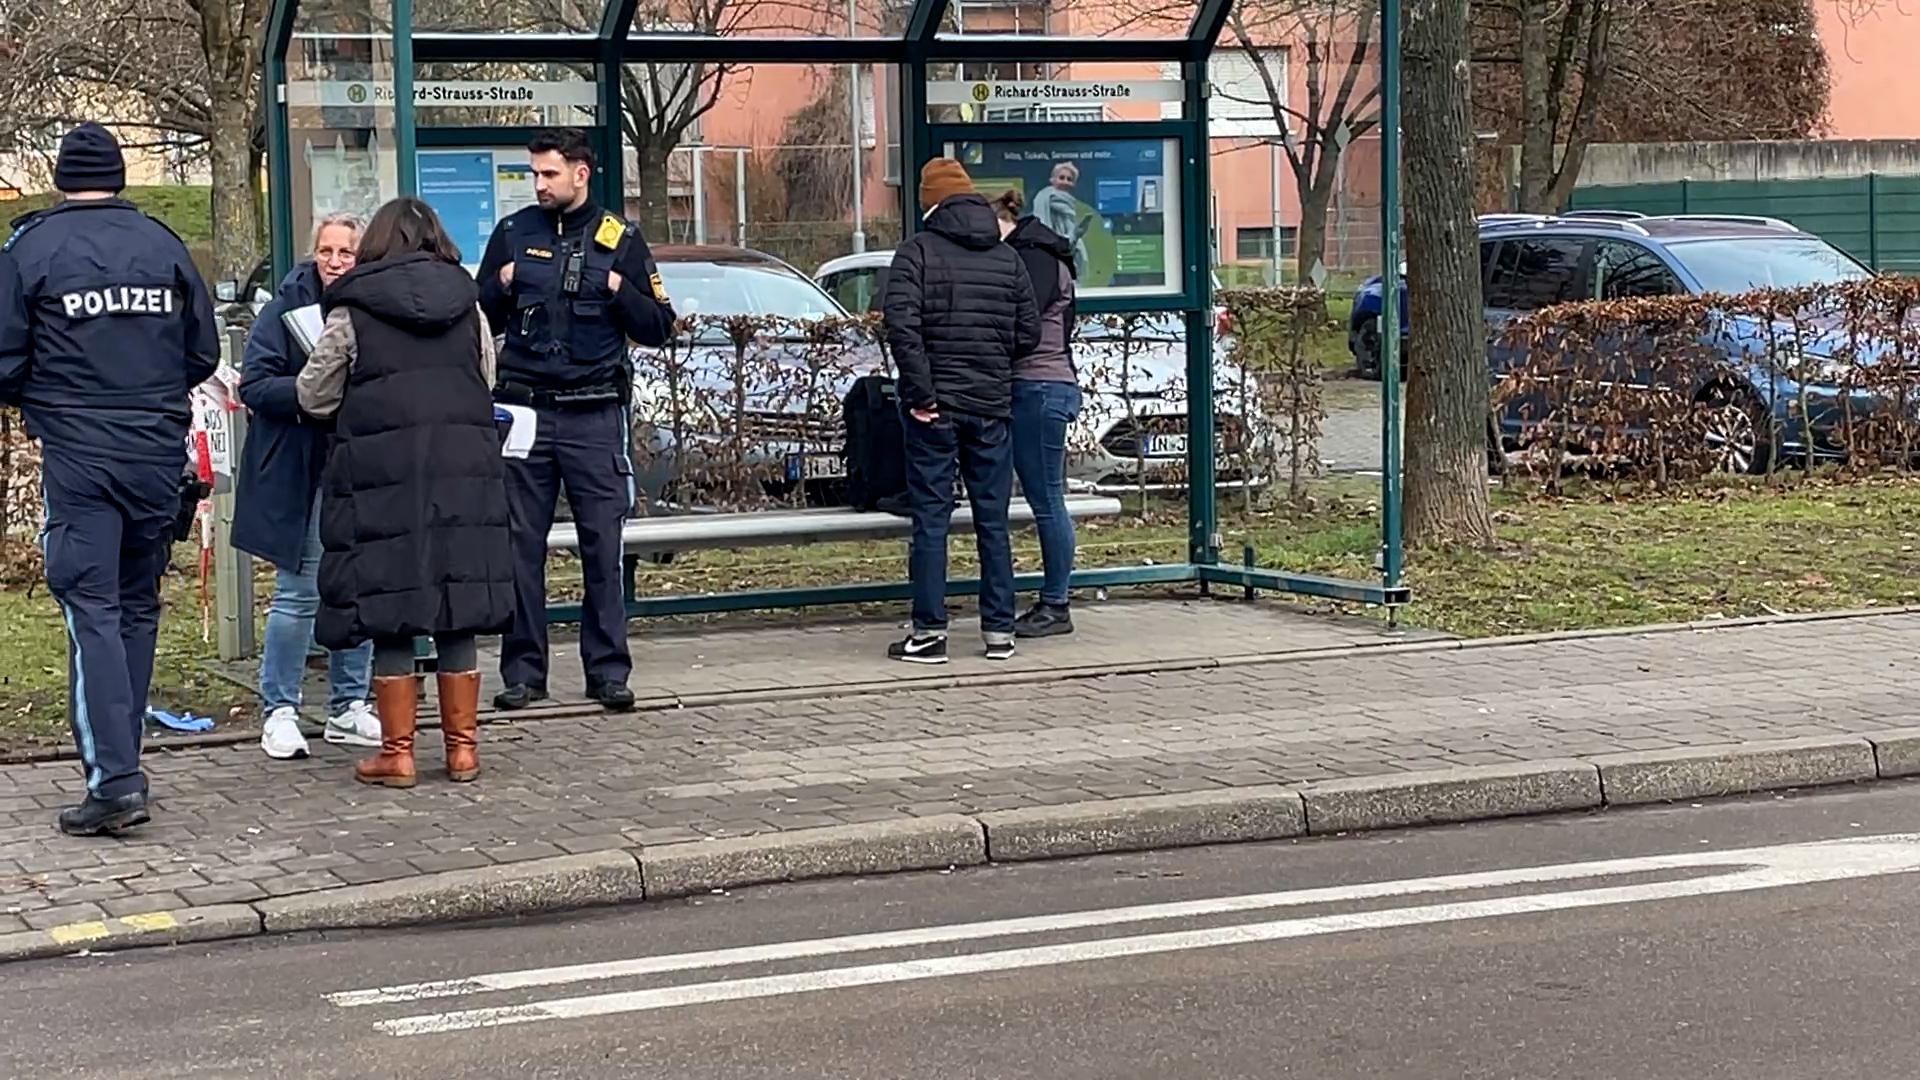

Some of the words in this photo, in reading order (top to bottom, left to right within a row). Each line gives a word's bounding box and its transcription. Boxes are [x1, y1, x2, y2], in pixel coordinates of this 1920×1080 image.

[374, 86, 534, 101] Ricrd-Strauss-Straße
[994, 84, 1131, 98] Richard-Strauss-Straße
[62, 287, 173, 316] POLIZEI
[1151, 435, 1168, 452] IN
